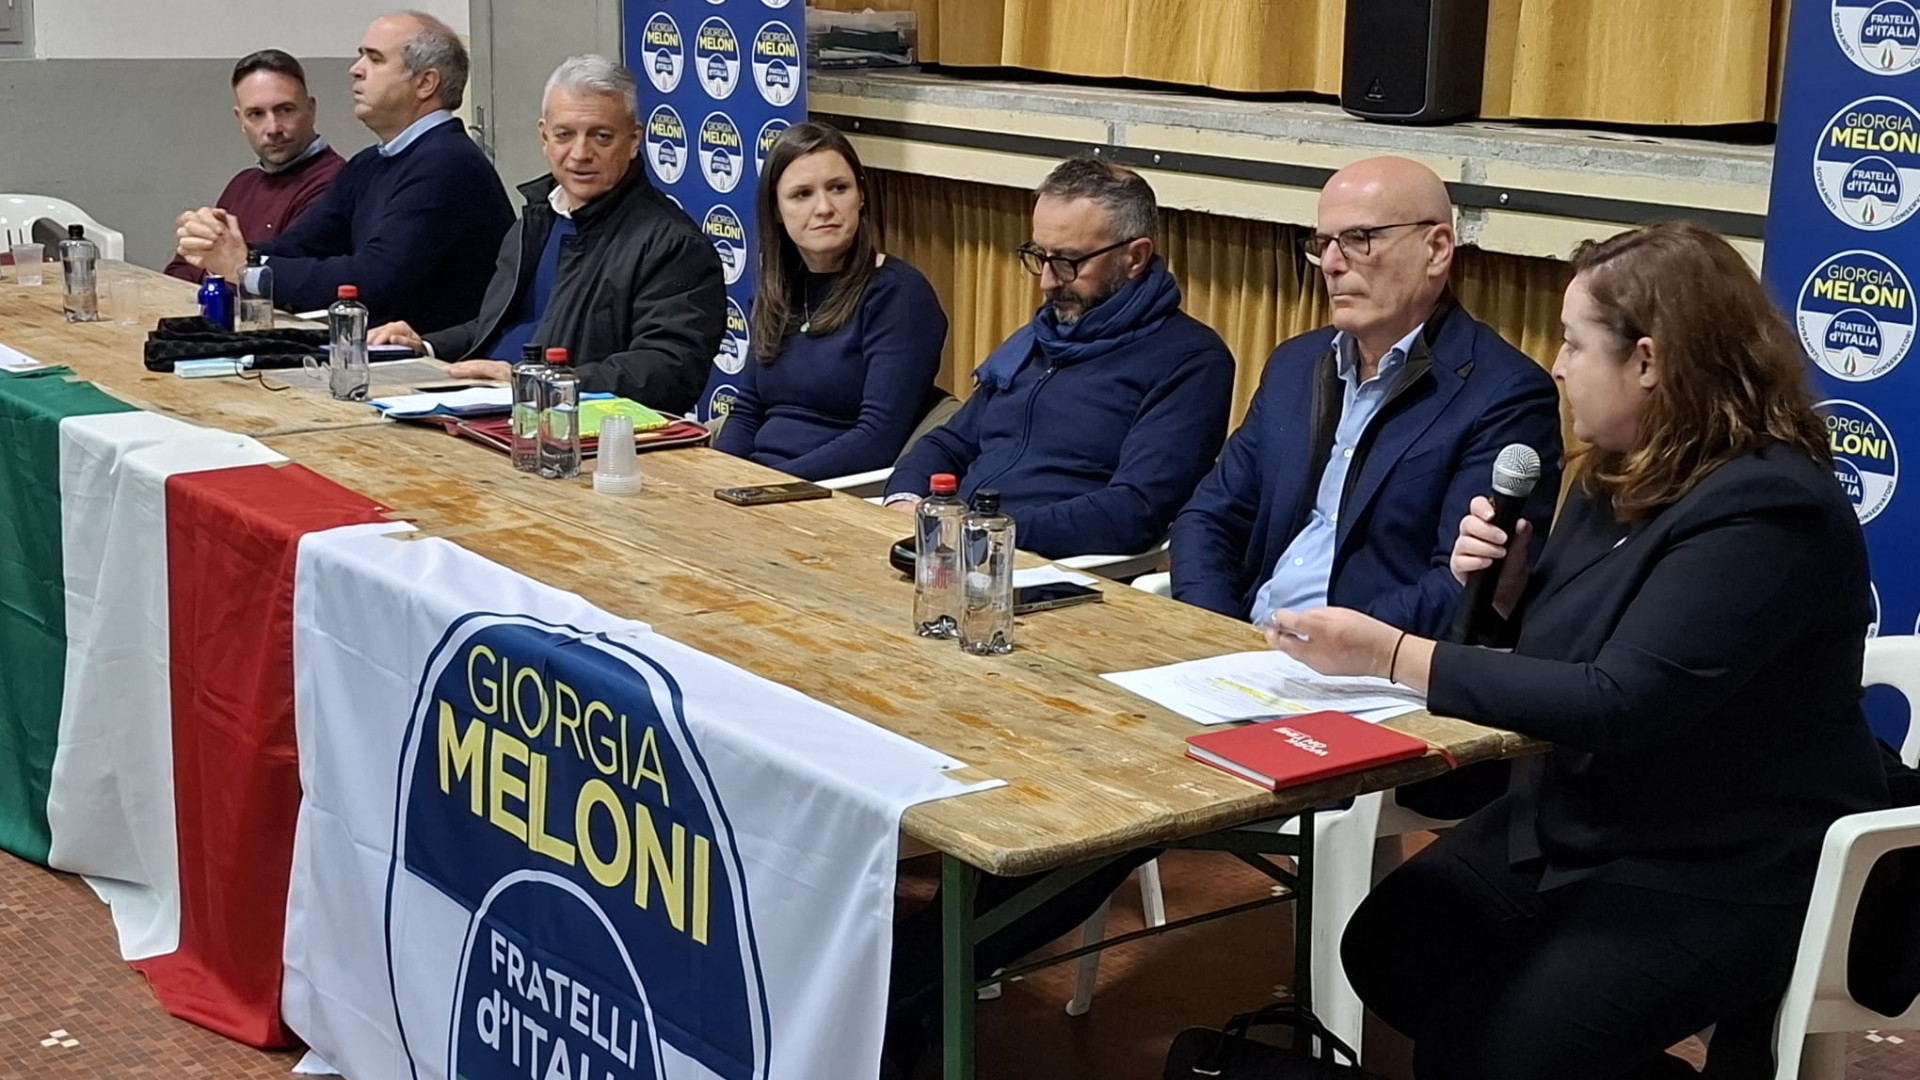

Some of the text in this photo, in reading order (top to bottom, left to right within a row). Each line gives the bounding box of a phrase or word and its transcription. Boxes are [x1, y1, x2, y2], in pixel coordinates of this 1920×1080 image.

[1871, 14, 1914, 24] FRATELLI
[647, 31, 678, 46] MELONI
[1865, 25, 1916, 38] d'ITALIA
[699, 36, 734, 51] MELONI
[757, 41, 796, 57] MELONI
[650, 122, 682, 139] MELONI
[1845, 112, 1914, 132] GIORGIA
[702, 130, 738, 147] MELONI
[1852, 169, 1895, 182] FRATELLI
[1847, 180, 1897, 196] d'ITALIA
[706, 221, 741, 240] MELONI
[1827, 264, 1894, 286] GIORGIA
[1813, 278, 1906, 309] MELONI
[1834, 321, 1877, 335] FRATELLI
[1829, 331, 1879, 348] d'ITALIA
[1872, 330, 1912, 376] CONSERVATORI
[1825, 415, 1876, 437] ORGIA
[1828, 430, 1887, 460] LONI
[1860, 481, 1894, 521] ONSERVATORI
[467, 645, 670, 808] GIORGIA
[438, 699, 710, 946] MELONI
[490, 928, 639, 1071] FRATELLI
[476, 990, 615, 1080] d'ITA
